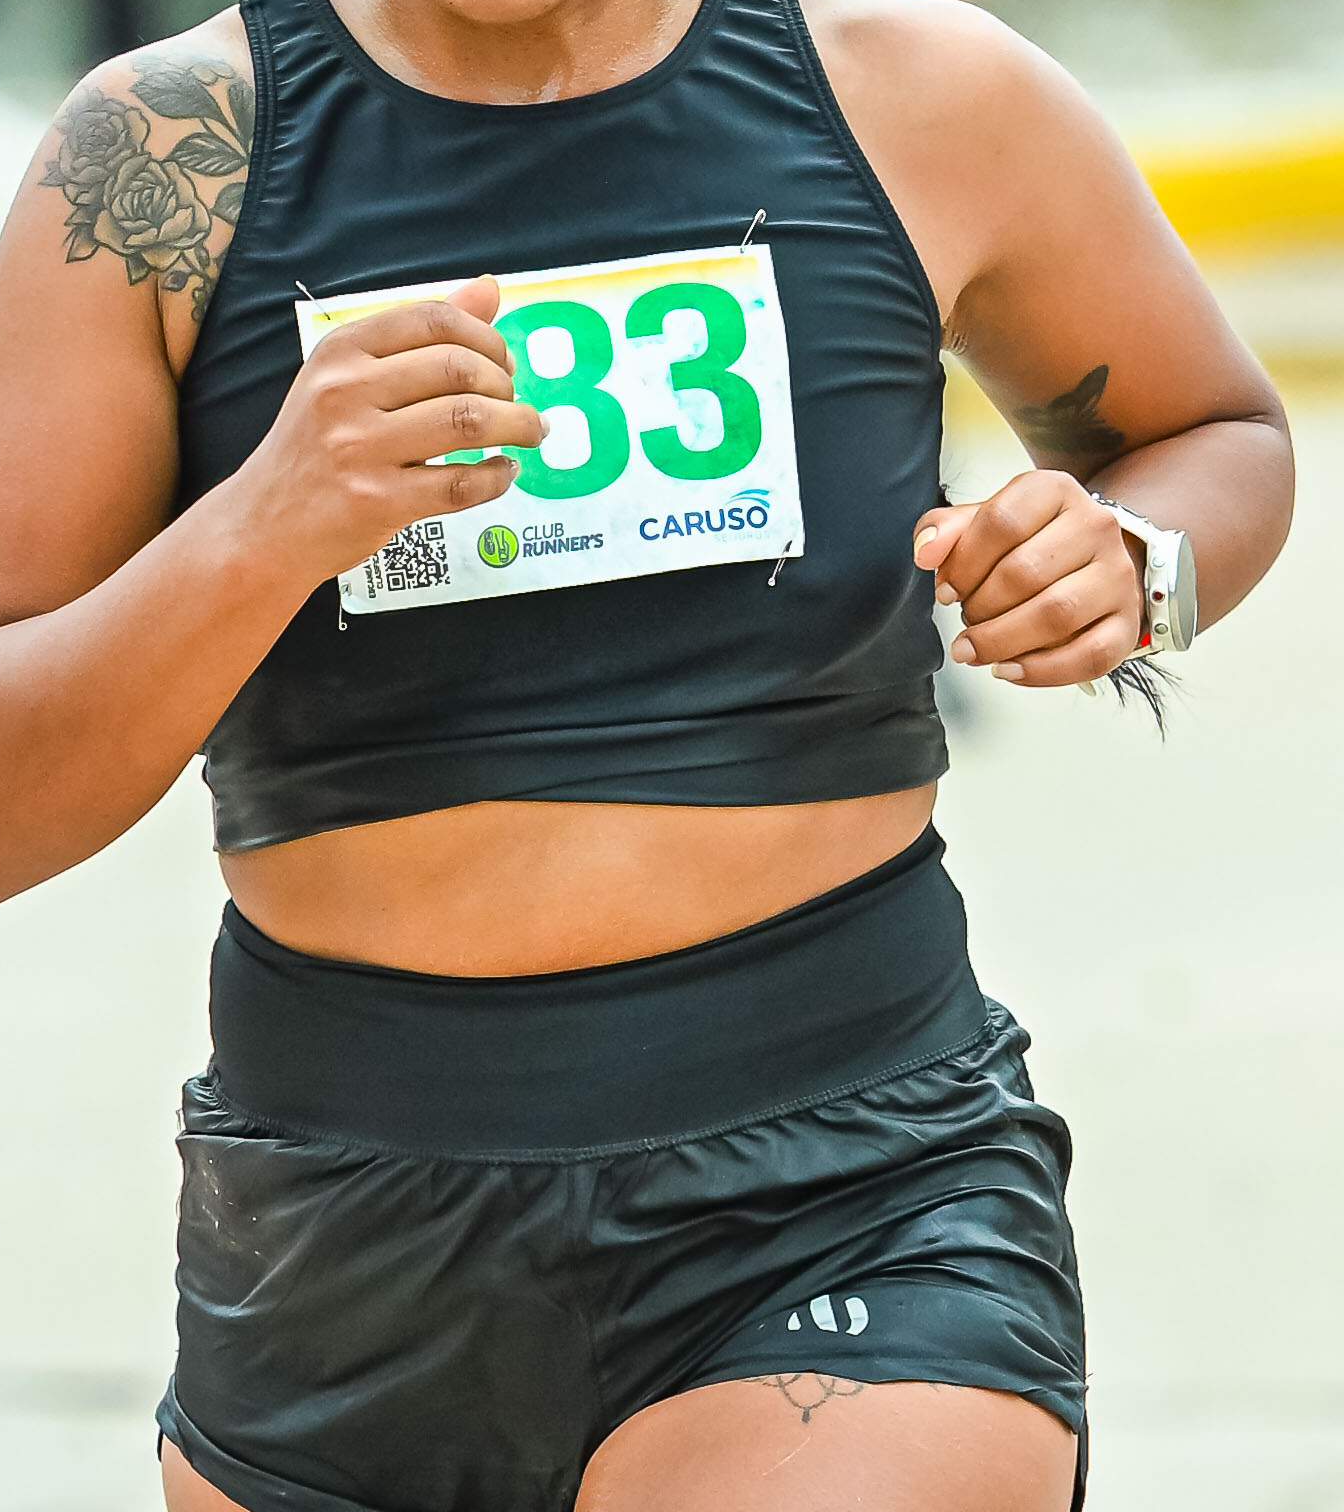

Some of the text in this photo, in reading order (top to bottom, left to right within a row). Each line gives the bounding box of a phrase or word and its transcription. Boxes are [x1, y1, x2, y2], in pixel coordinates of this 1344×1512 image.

[444, 282, 763, 500] 83
[522, 522, 565, 542] CLUB
[639, 505, 768, 541] CARUSO
[522, 533, 604, 558] RUNNER'S
